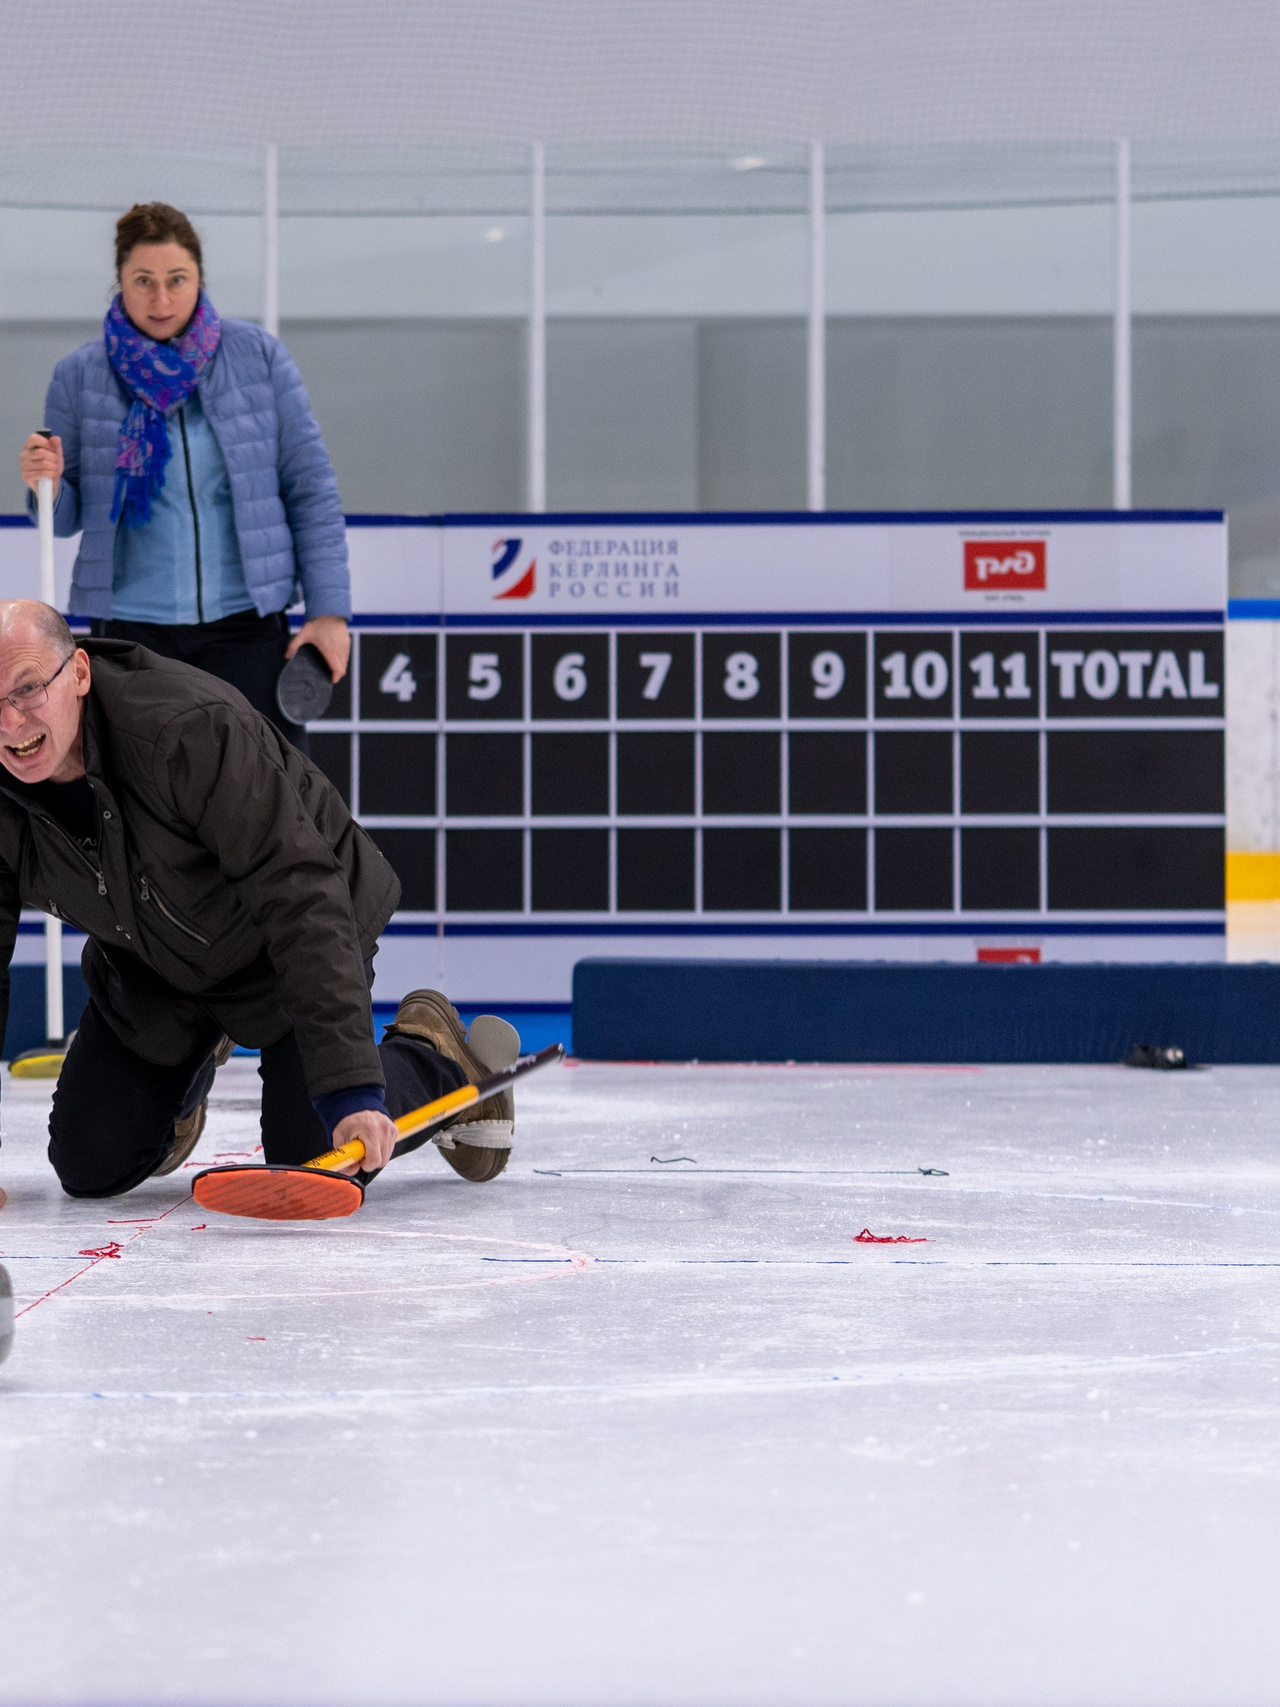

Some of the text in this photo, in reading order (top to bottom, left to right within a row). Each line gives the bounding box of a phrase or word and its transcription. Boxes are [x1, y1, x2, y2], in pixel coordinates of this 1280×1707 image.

[548, 540, 679, 555] ФЕДЕРАЦИЯ
[548, 559, 680, 577] КЁРЛИНГА
[548, 582, 680, 597] РОССИИ
[380, 654, 417, 702] 4
[468, 653, 502, 701] 5
[553, 653, 587, 701] 6
[639, 653, 672, 700] 7
[723, 652, 760, 701] 8
[811, 651, 846, 699] 9
[881, 651, 949, 699] 10
[969, 652, 1031, 699] 11
[1050, 650, 1219, 699] TOTAL
